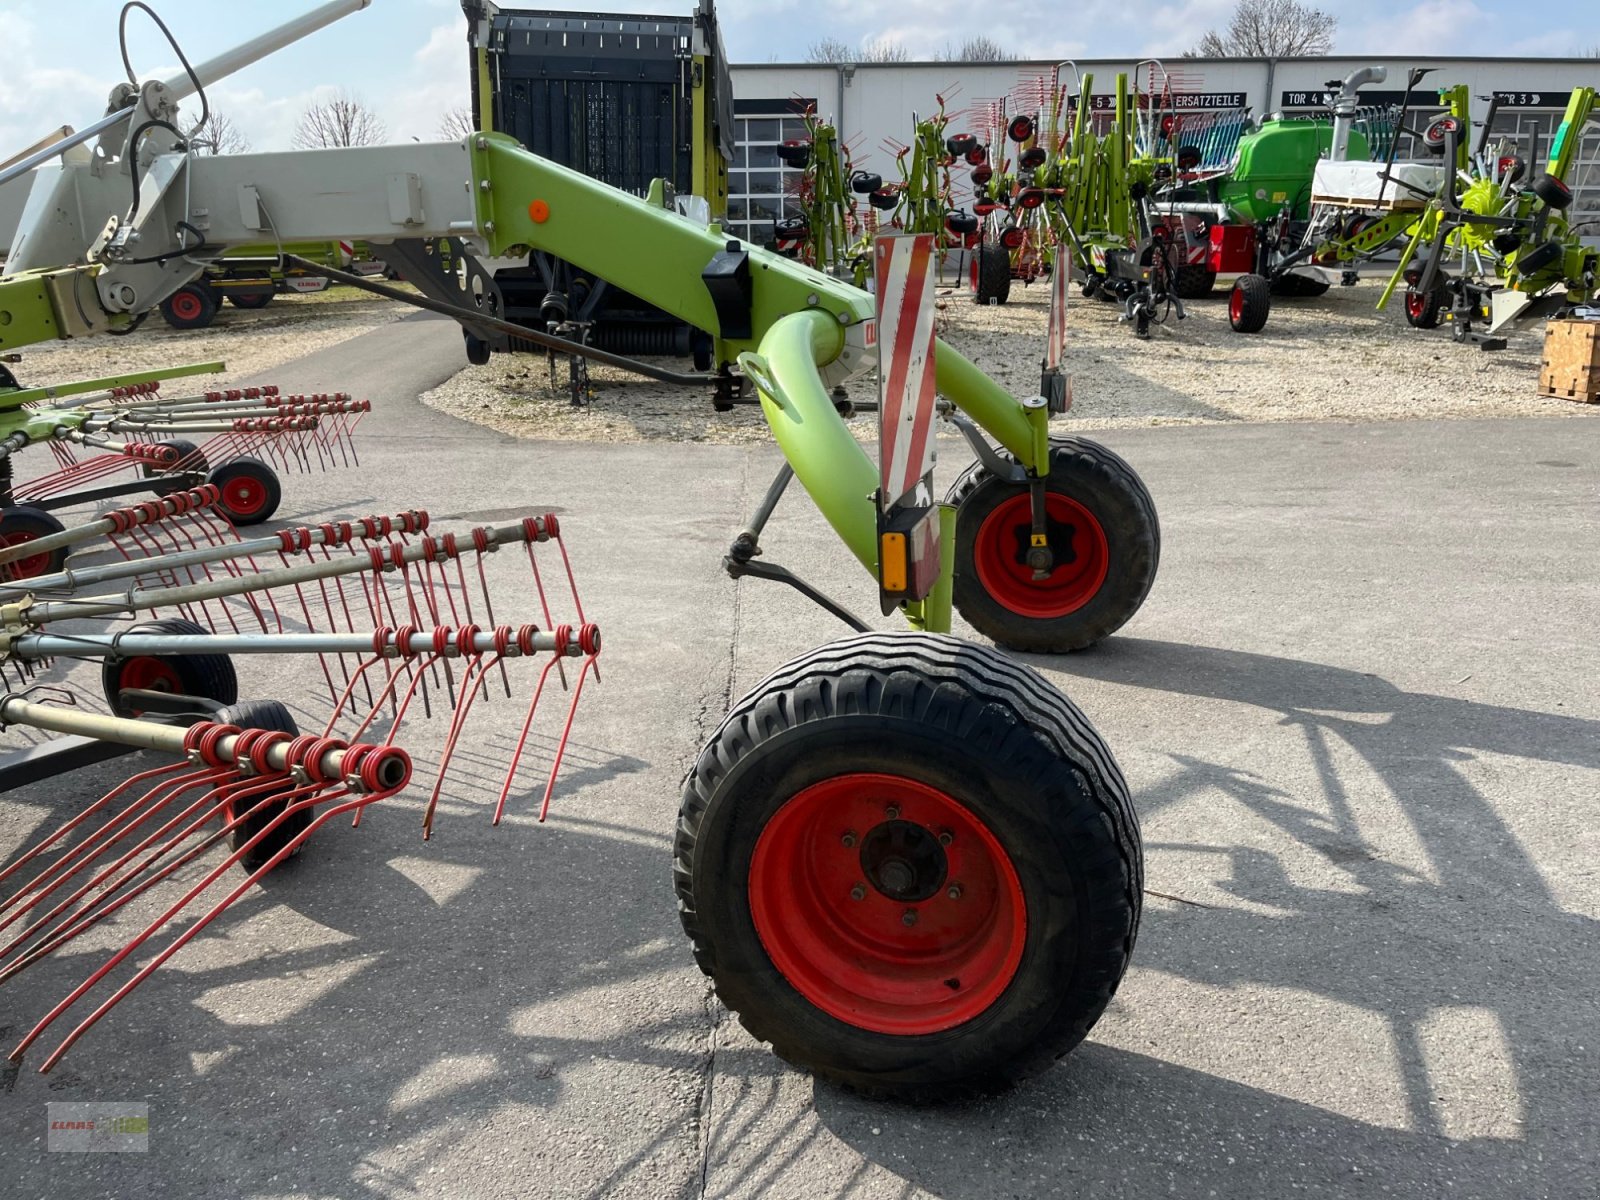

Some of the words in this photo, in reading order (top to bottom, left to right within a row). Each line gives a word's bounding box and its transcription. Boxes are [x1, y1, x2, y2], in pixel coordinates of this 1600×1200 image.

[1096, 97, 1103, 108] 5
[1175, 95, 1240, 107] ERSATZTEILE
[1288, 93, 1306, 104] TOR
[1311, 93, 1318, 104] 4
[1519, 94, 1527, 105] 3
